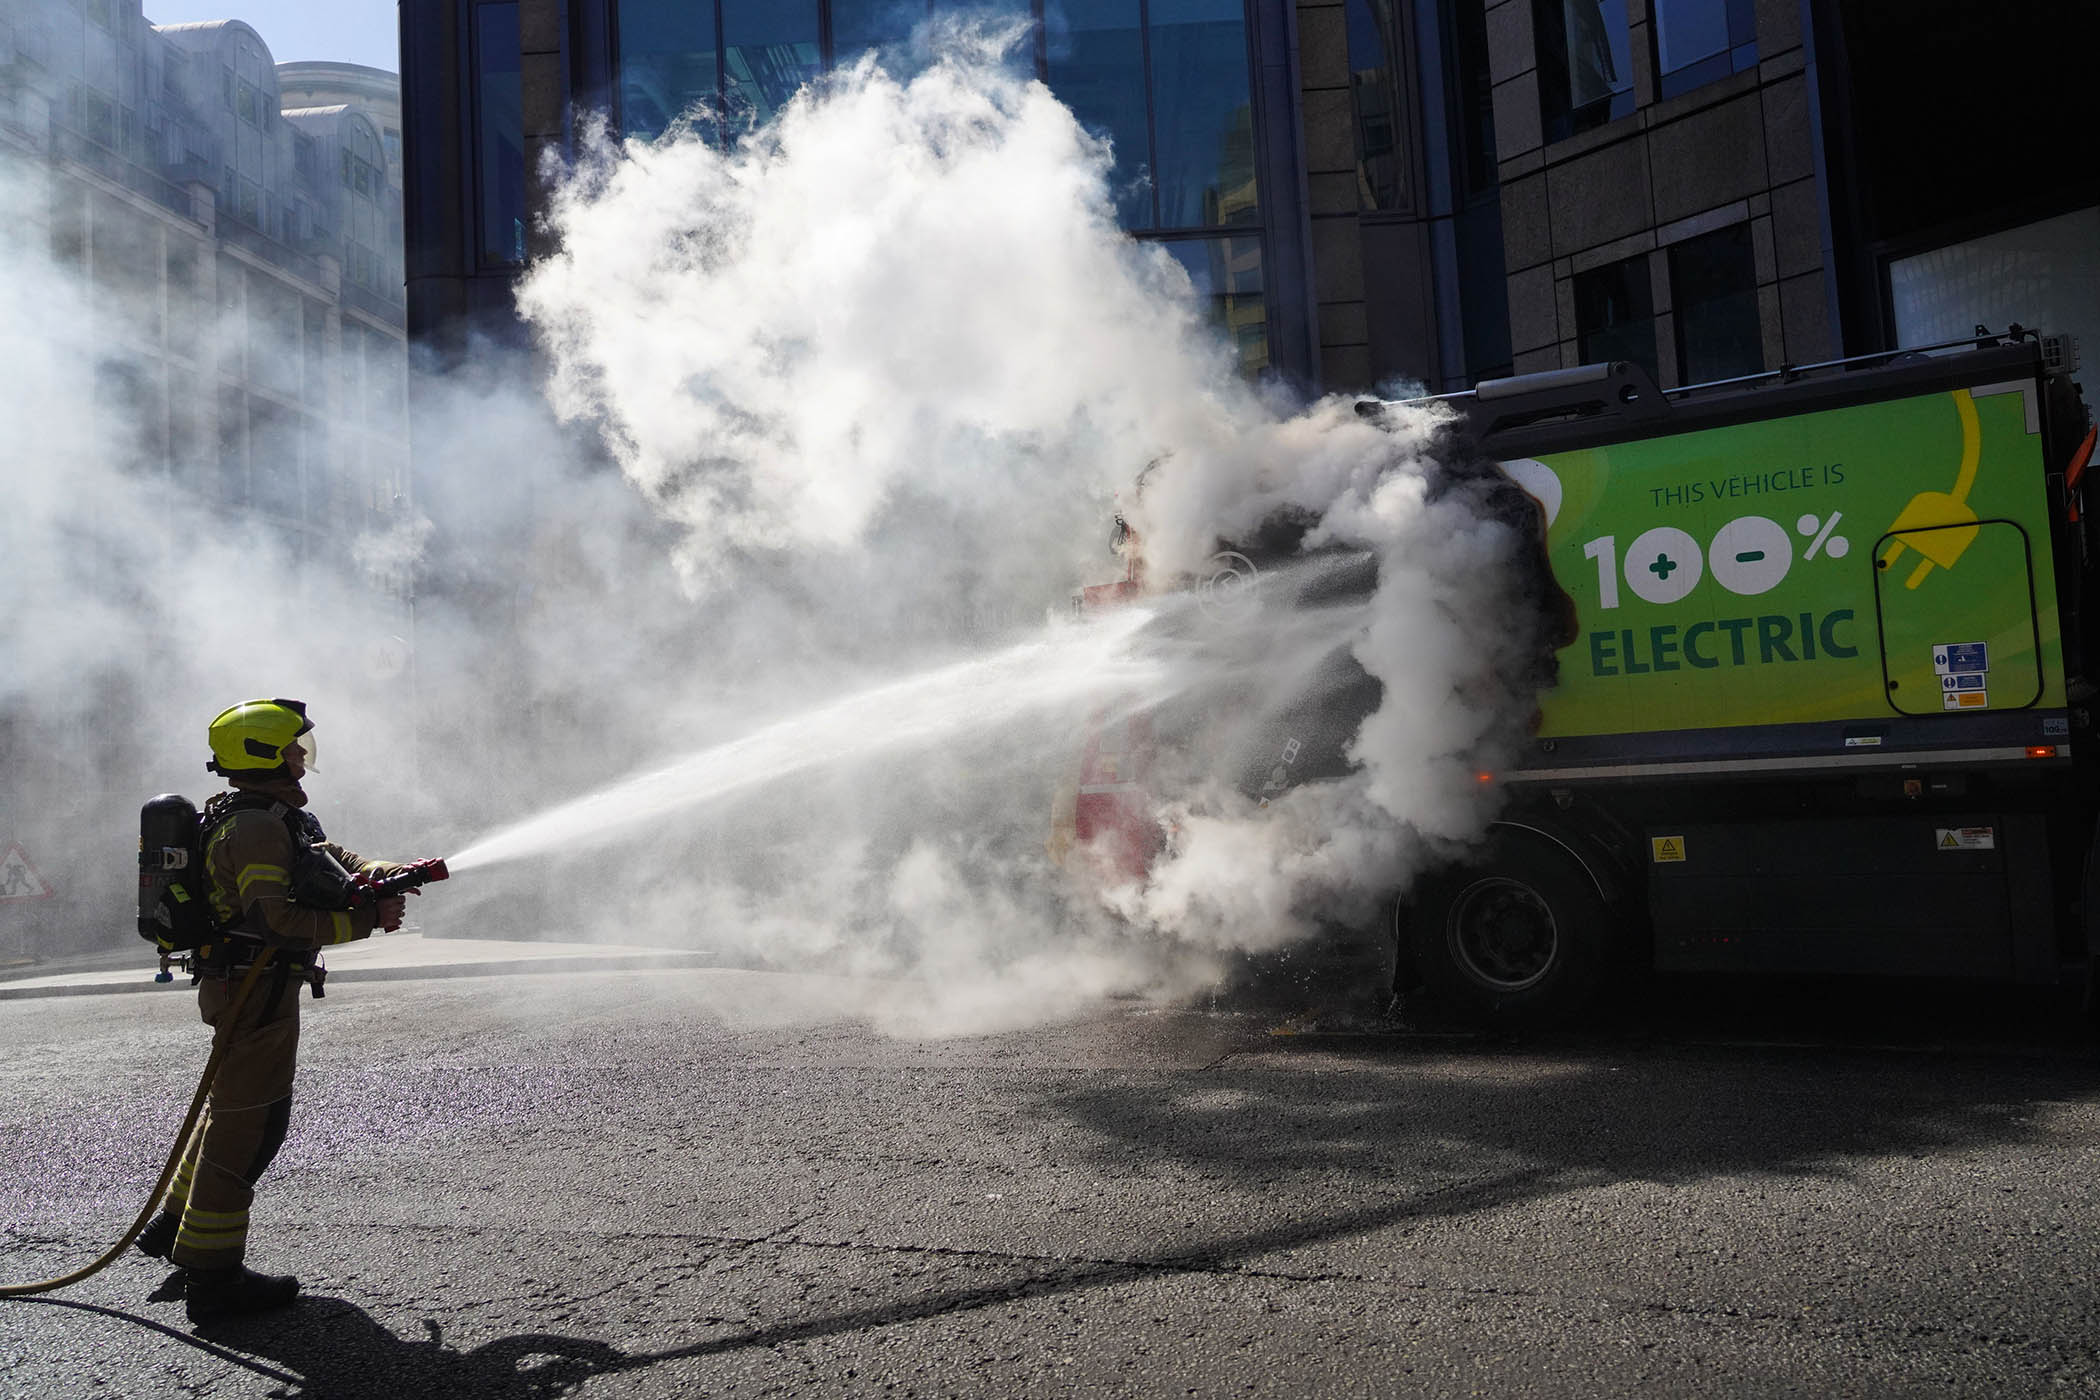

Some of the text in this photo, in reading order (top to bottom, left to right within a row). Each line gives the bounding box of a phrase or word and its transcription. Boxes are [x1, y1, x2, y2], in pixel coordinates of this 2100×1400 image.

[1651, 464, 1846, 508] THIS VEHICLE IS
[1583, 510, 1850, 609] 100%
[1589, 609, 1859, 677] ELECTRIC
